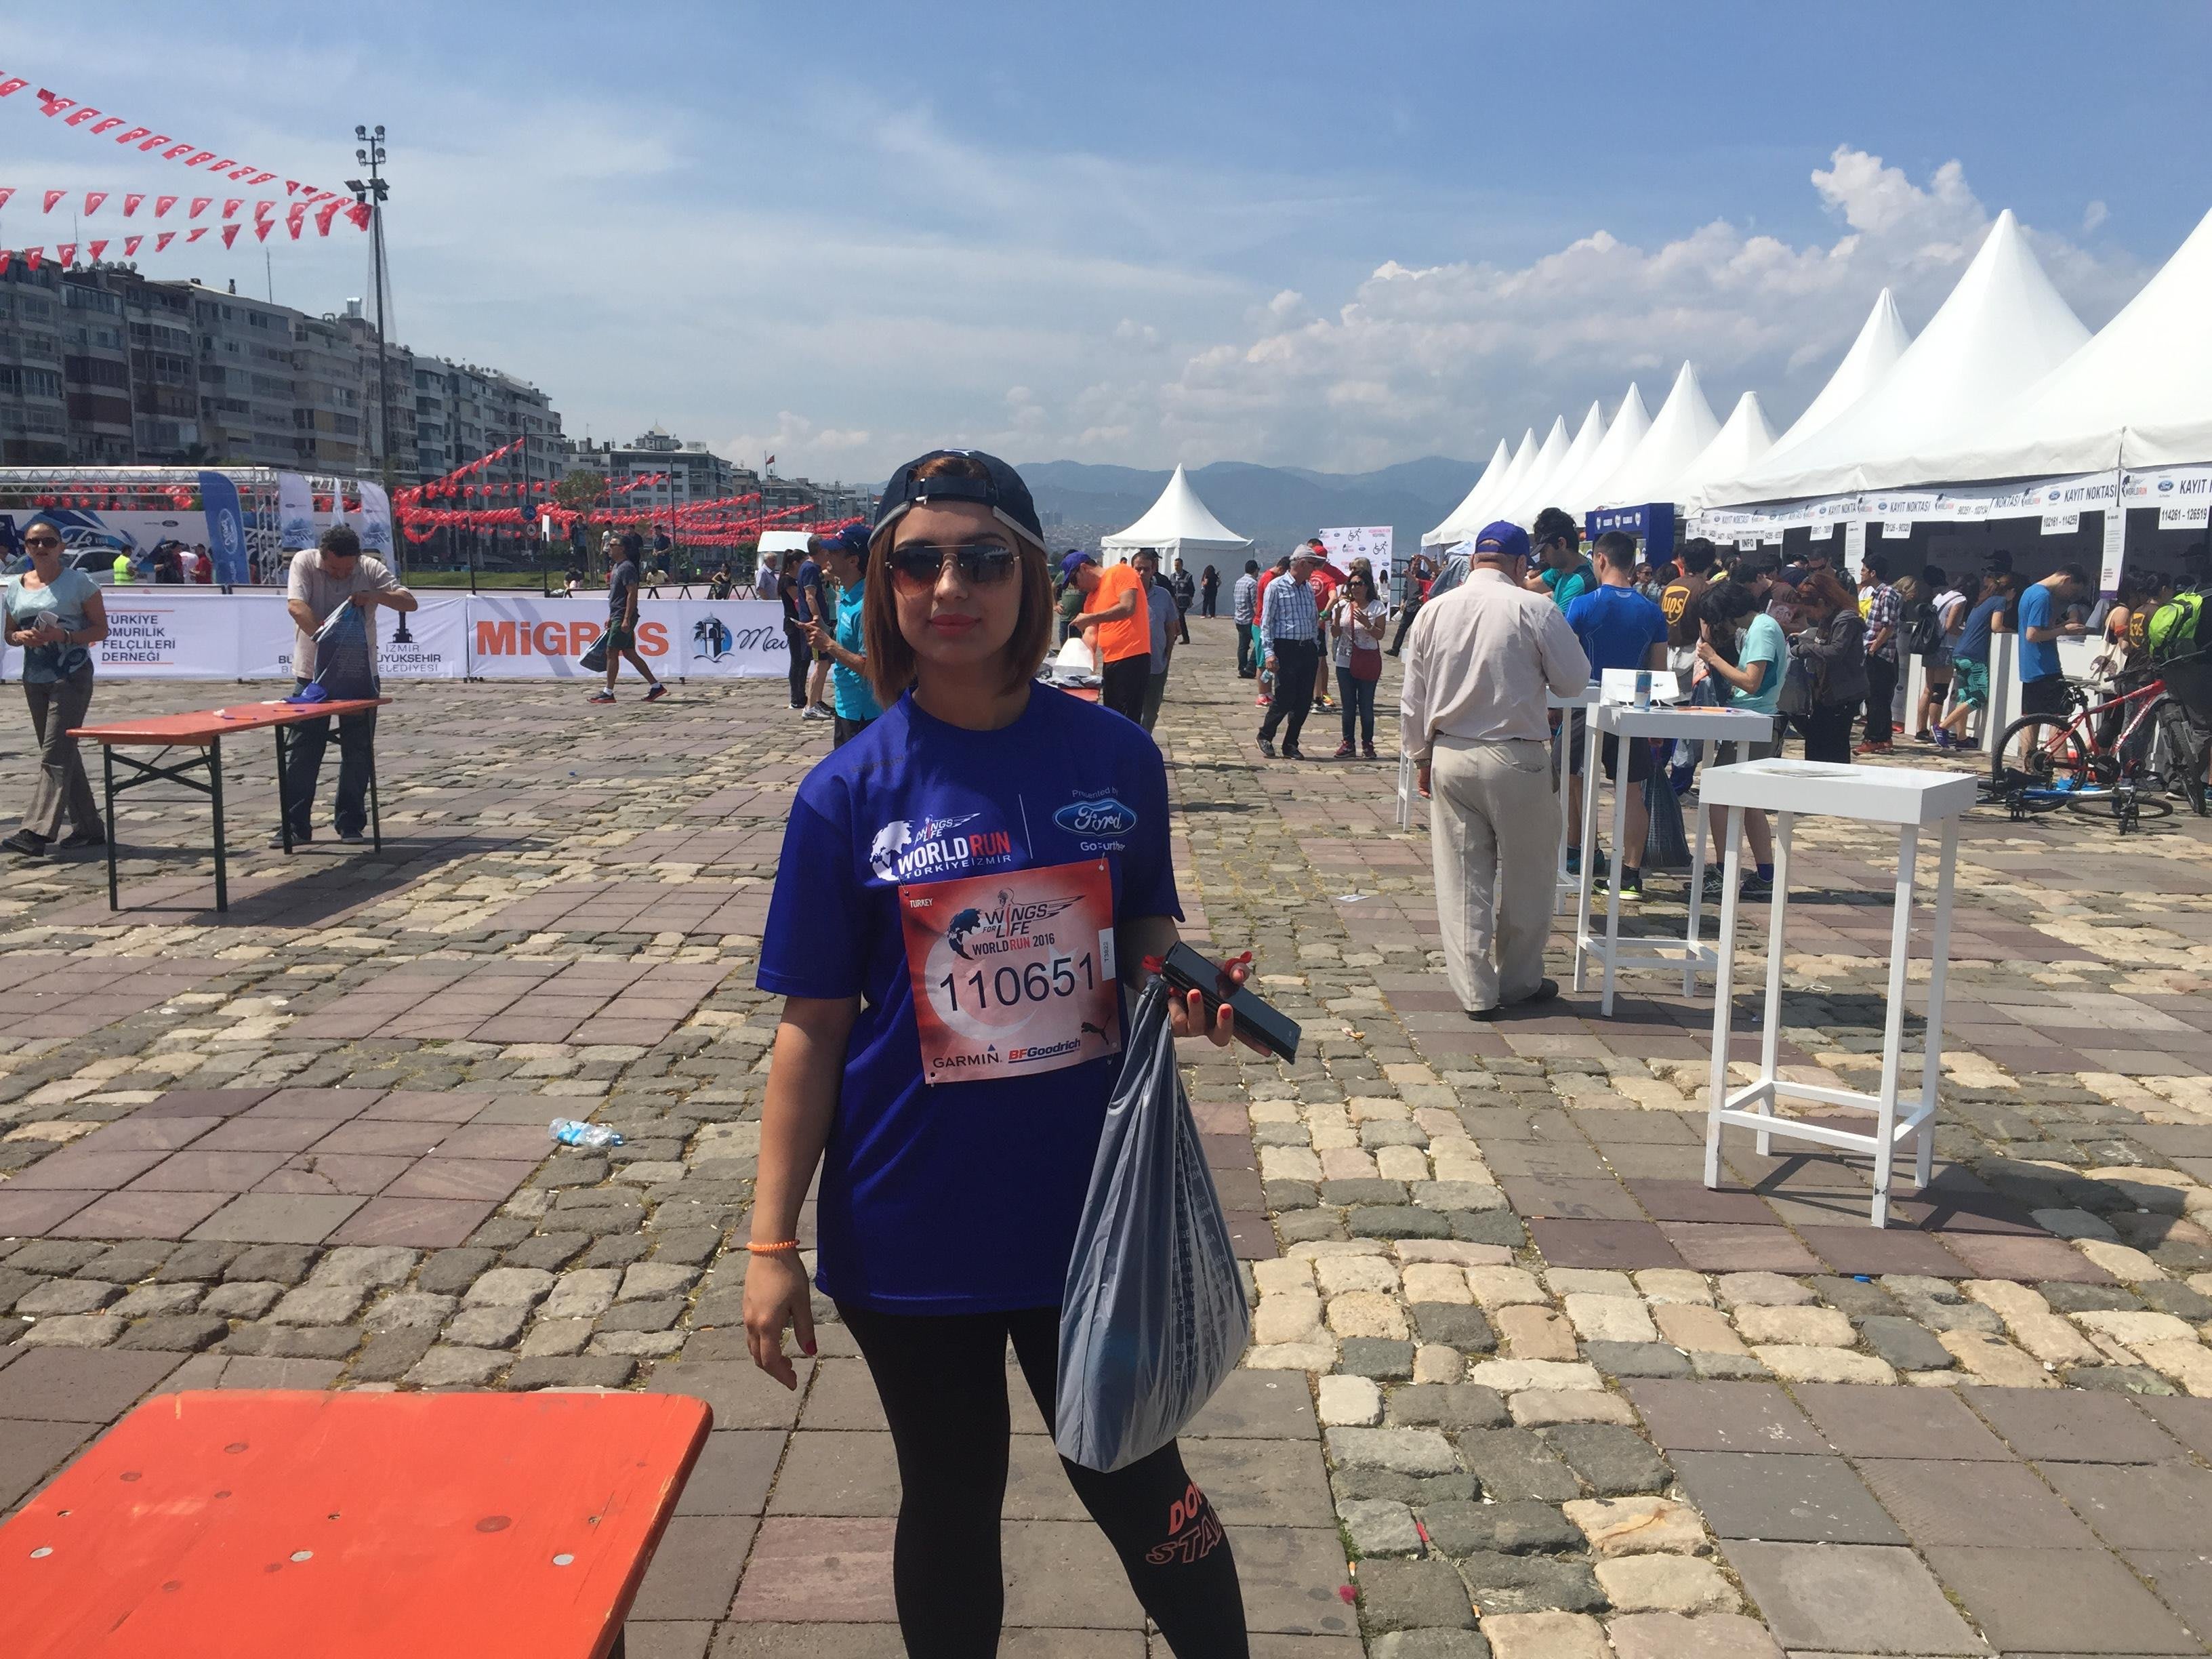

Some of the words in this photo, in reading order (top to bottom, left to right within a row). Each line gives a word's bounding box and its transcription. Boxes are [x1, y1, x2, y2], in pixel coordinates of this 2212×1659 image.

[2064, 487, 2085, 502] KAYIT
[2086, 484, 2117, 500] NOKTASI
[2179, 478, 2207, 494] KAYIT
[1890, 501, 1906, 512] KAYIT
[1906, 500, 1931, 512] NOKTASI
[1994, 495, 2021, 508] NOKTASI
[2162, 508, 2182, 521] 114261
[2186, 508, 2207, 521] 126519
[1742, 538, 1754, 548] INFO
[1663, 596, 1684, 619] ups
[102, 638, 176, 651] FELÇLİLERİ
[477, 621, 669, 655] MiGRS
[102, 651, 160, 661] DERNEĞİ
[377, 653, 441, 663] ÜYÜKŞEHİR
[379, 664, 438, 672] ELEDİYESİ
[1074, 804, 1122, 832] Ford
[897, 837, 969, 875] WORLD
[968, 830, 1012, 857] RUN
[909, 898, 933, 909] TURKEY
[985, 903, 1048, 924] WINGS
[983, 924, 996, 934] FOR
[995, 920, 1033, 939] LIFE
[972, 939, 1009, 956] WORLD
[1009, 936, 1031, 950] RUN
[1032, 933, 1055, 948] 2016
[940, 951, 1094, 1012] 110651
[933, 1051, 1000, 1069] GARMIN
[1008, 1038, 1081, 1060] BFGoodrich
